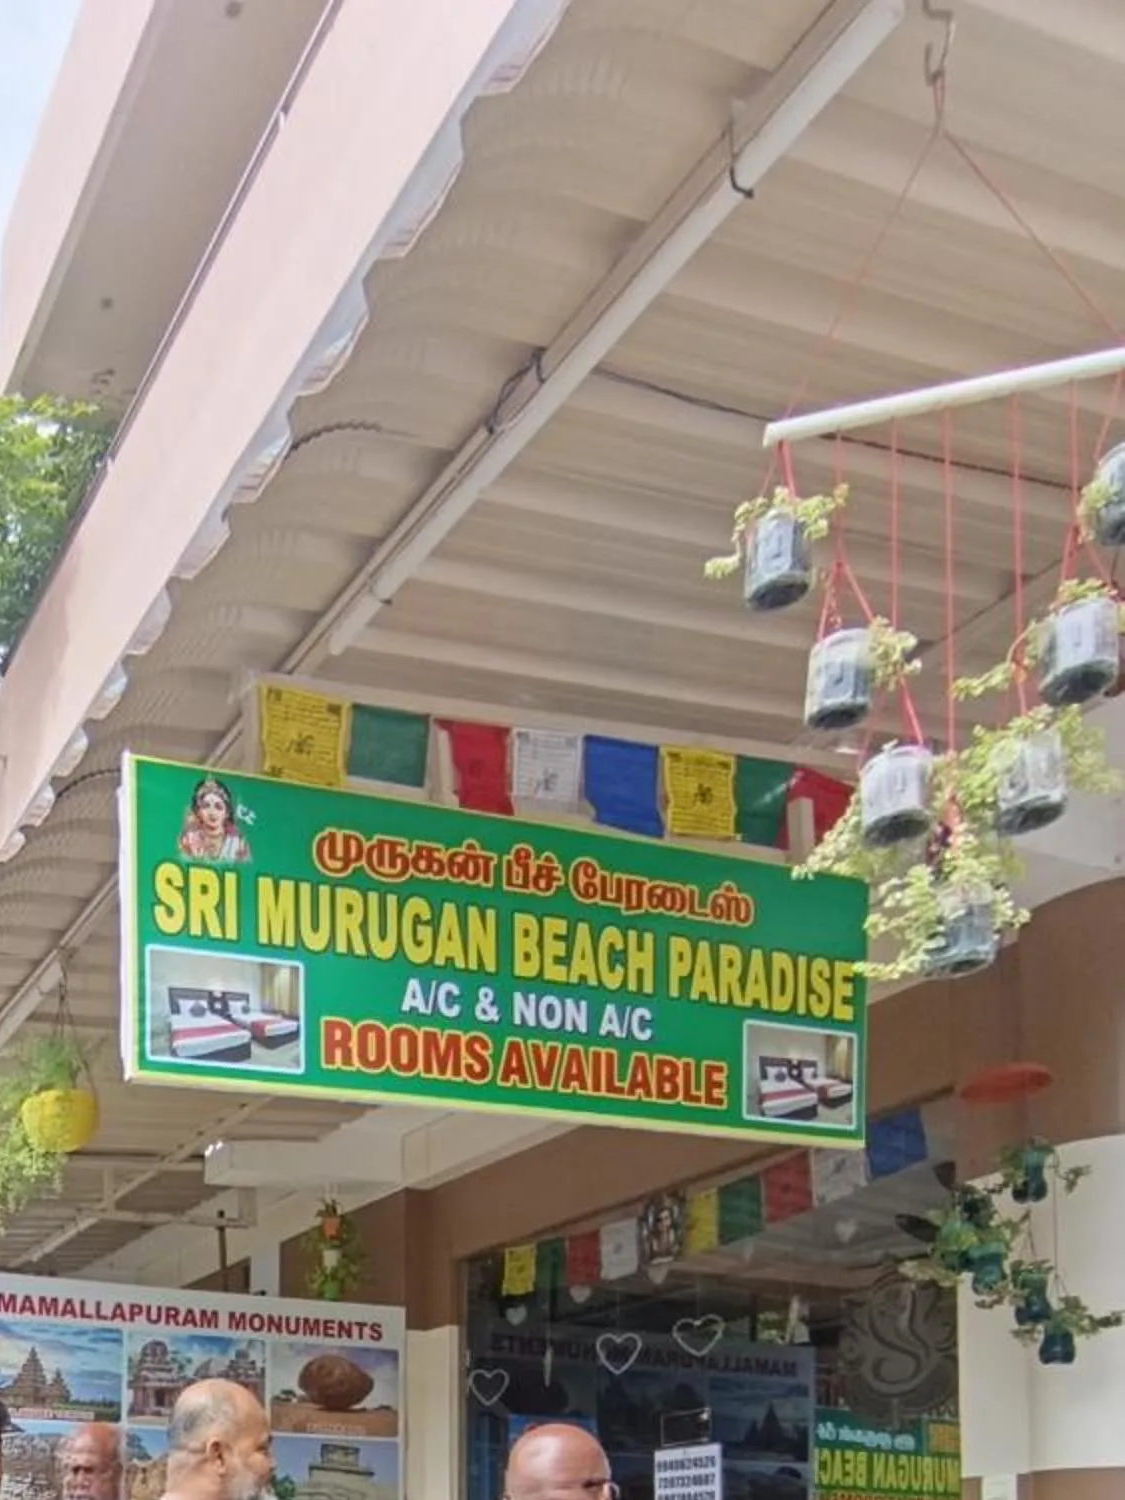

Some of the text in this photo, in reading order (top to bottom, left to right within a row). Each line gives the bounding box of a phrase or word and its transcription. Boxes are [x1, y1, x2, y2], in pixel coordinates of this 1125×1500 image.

[314, 827, 755, 926] முருகன் பீச் பேரடைஸ்
[152, 861, 856, 1021] SRI MURUGAN BEACH PARADISE
[401, 977, 654, 1042] A/C & NON A/C
[321, 1017, 729, 1109] ROOMS AVAILABLE
[228, 1311, 383, 1342] MONUMENTS
